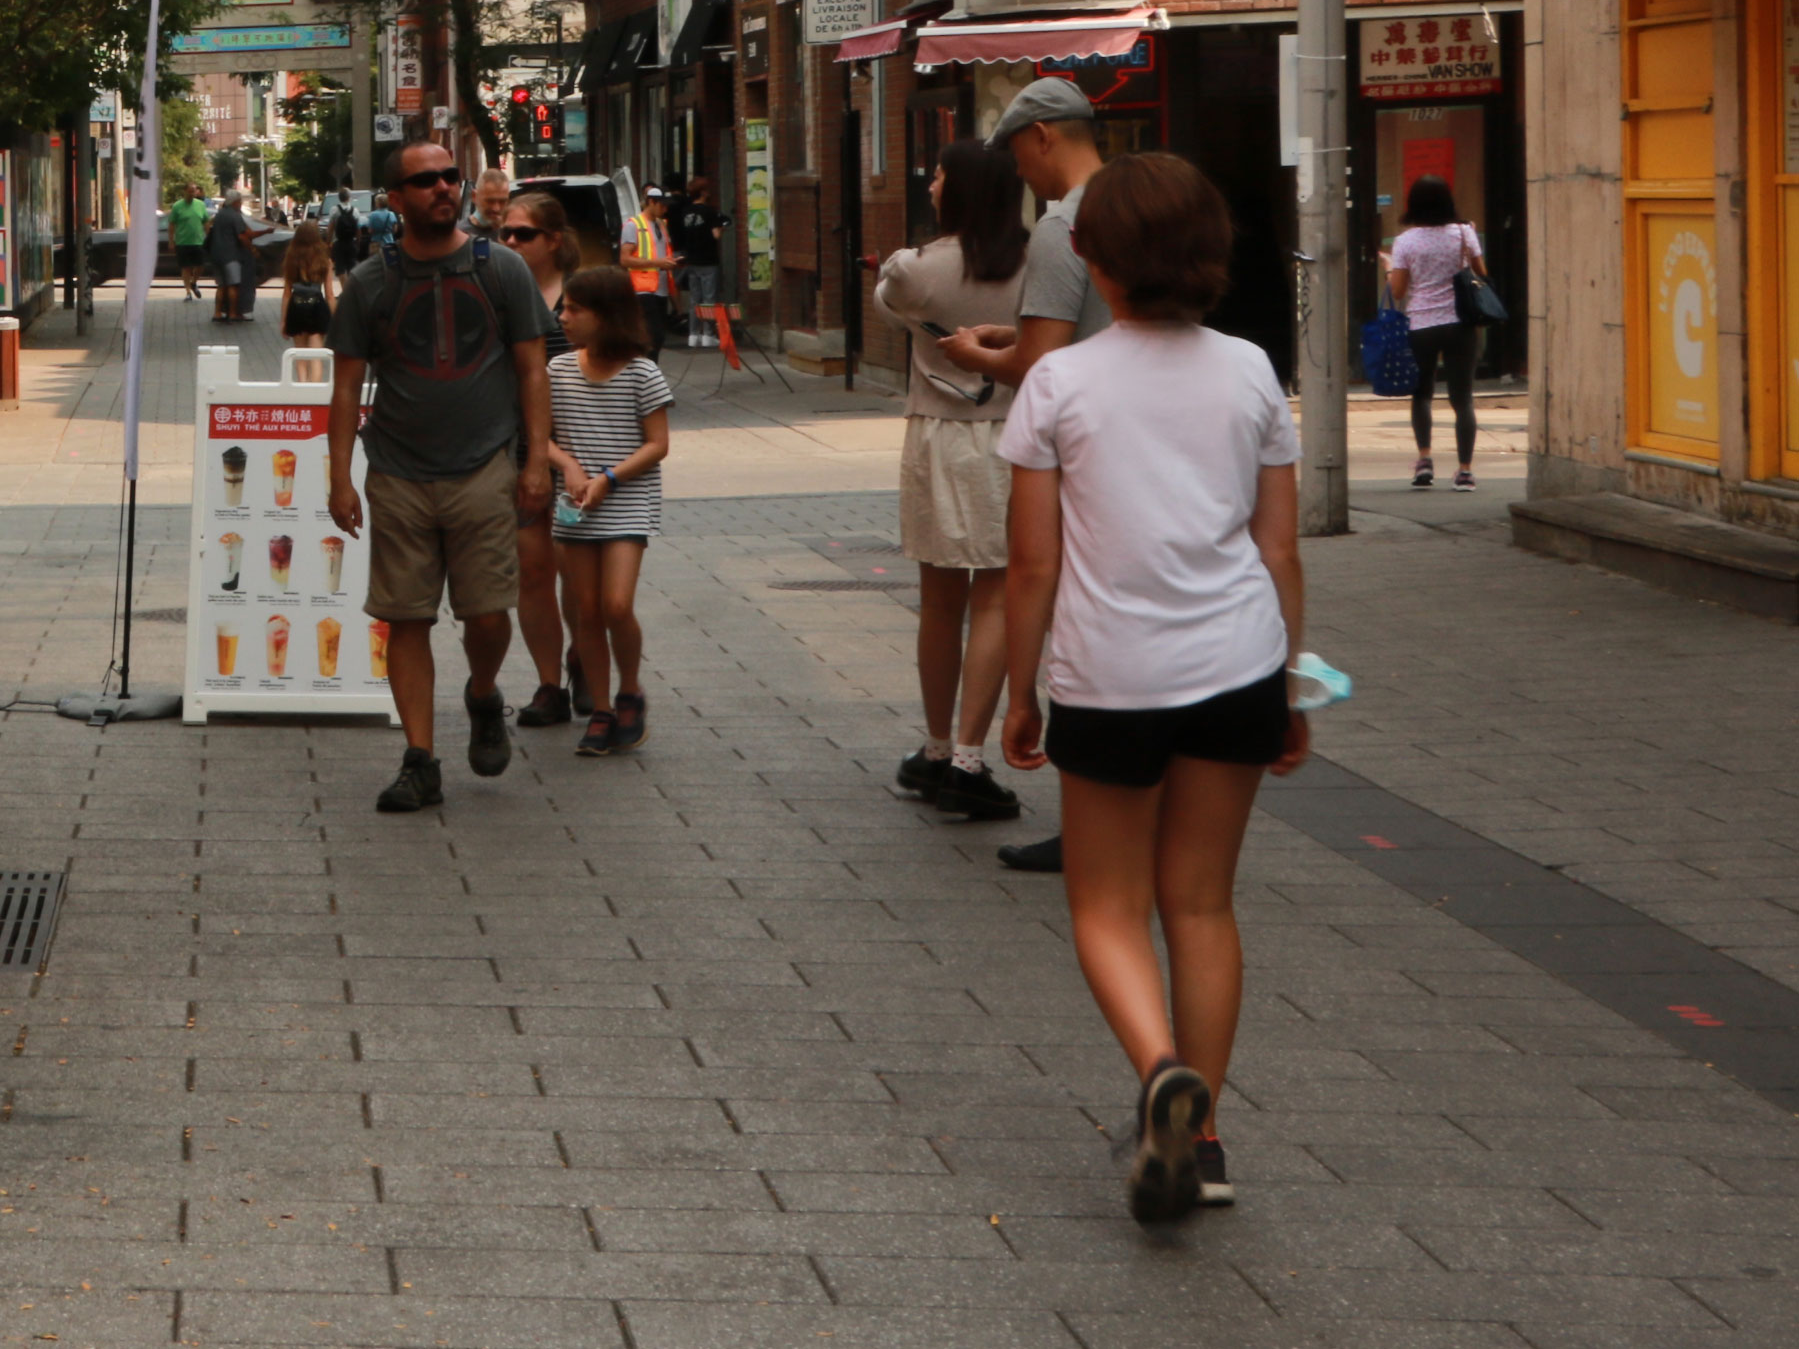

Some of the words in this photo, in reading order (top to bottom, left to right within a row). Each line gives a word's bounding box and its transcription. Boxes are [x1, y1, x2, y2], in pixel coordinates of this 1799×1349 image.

[813, 5, 865, 13] LIVRAISON
[820, 14, 857, 23] LOCALE
[816, 25, 828, 33] DE
[1428, 65, 1453, 79] VAN
[1455, 62, 1494, 78] SHOW
[1410, 107, 1442, 121] 1027
[245, 423, 260, 431] THÉ
[280, 424, 312, 432] PERLES
